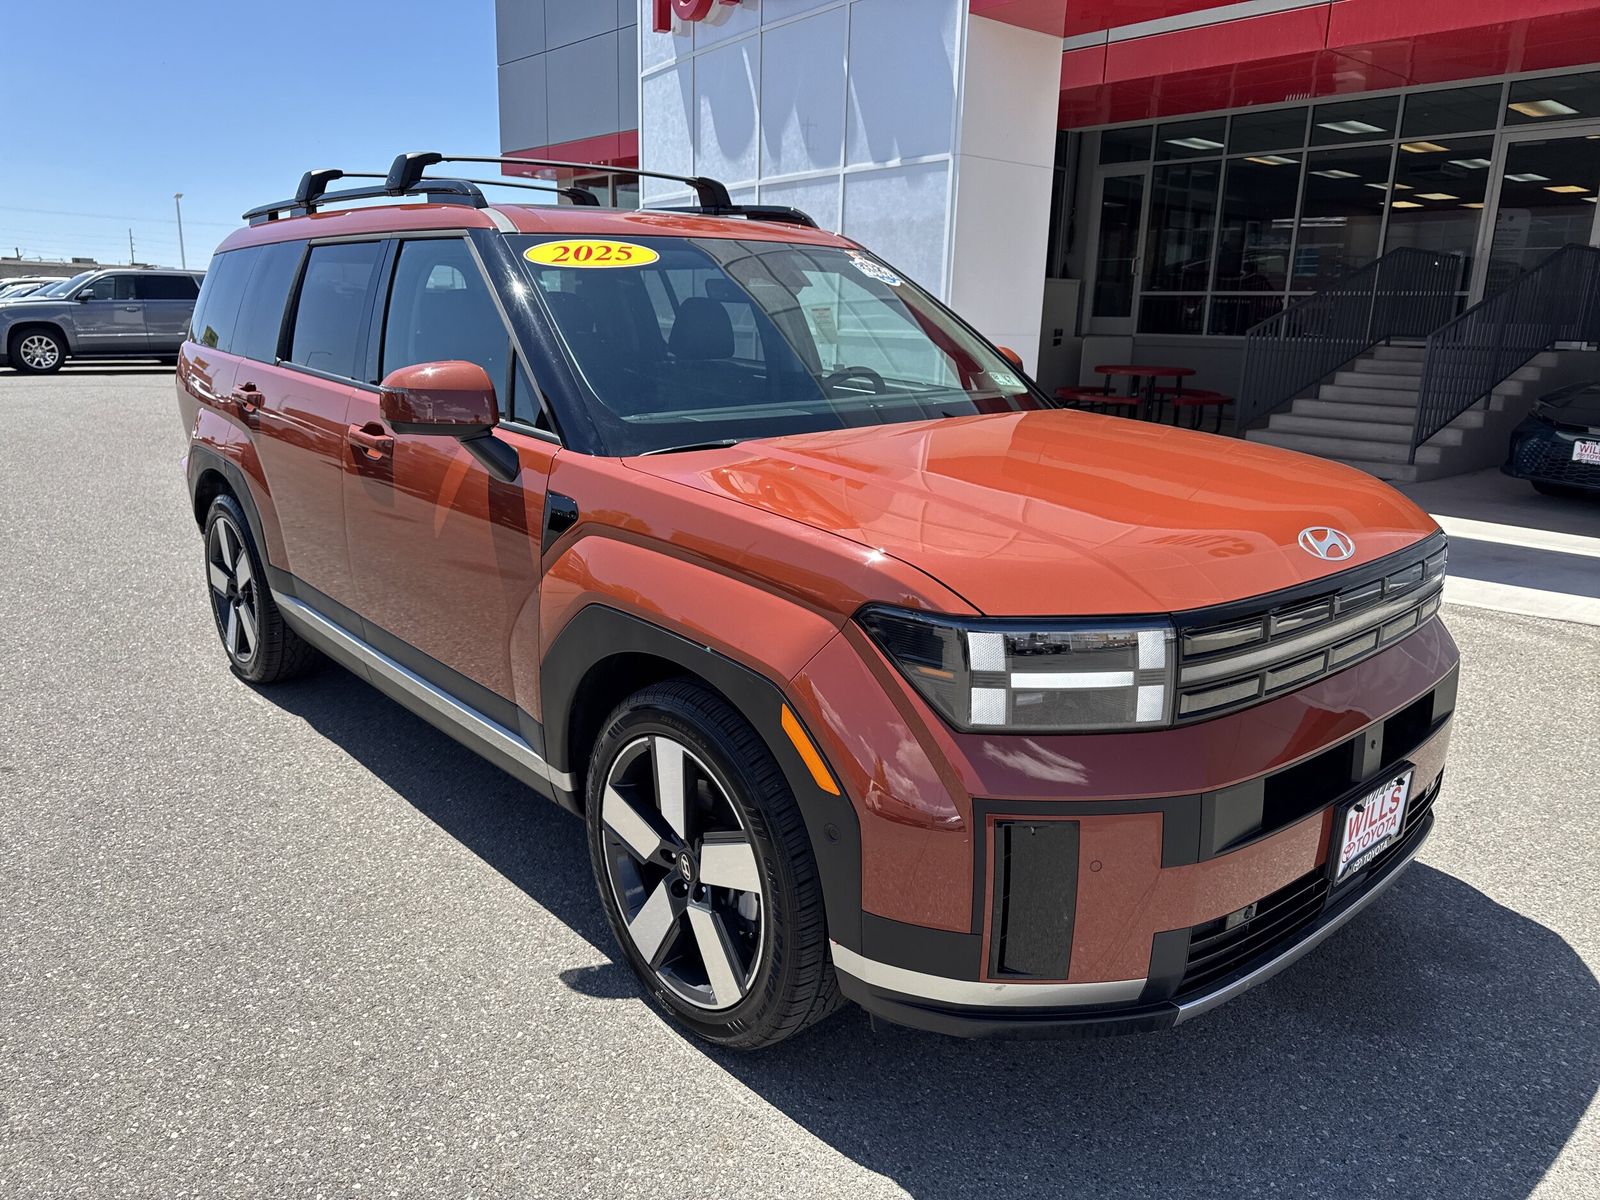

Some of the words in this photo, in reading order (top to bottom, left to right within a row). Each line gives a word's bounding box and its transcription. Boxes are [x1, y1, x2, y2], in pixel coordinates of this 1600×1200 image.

[551, 245, 633, 262] 2025
[1580, 444, 1600, 455] WIL
[1348, 787, 1402, 842] WILLS
[1356, 814, 1397, 852] TOYOTA
[1364, 840, 1388, 863] TOYOTA
